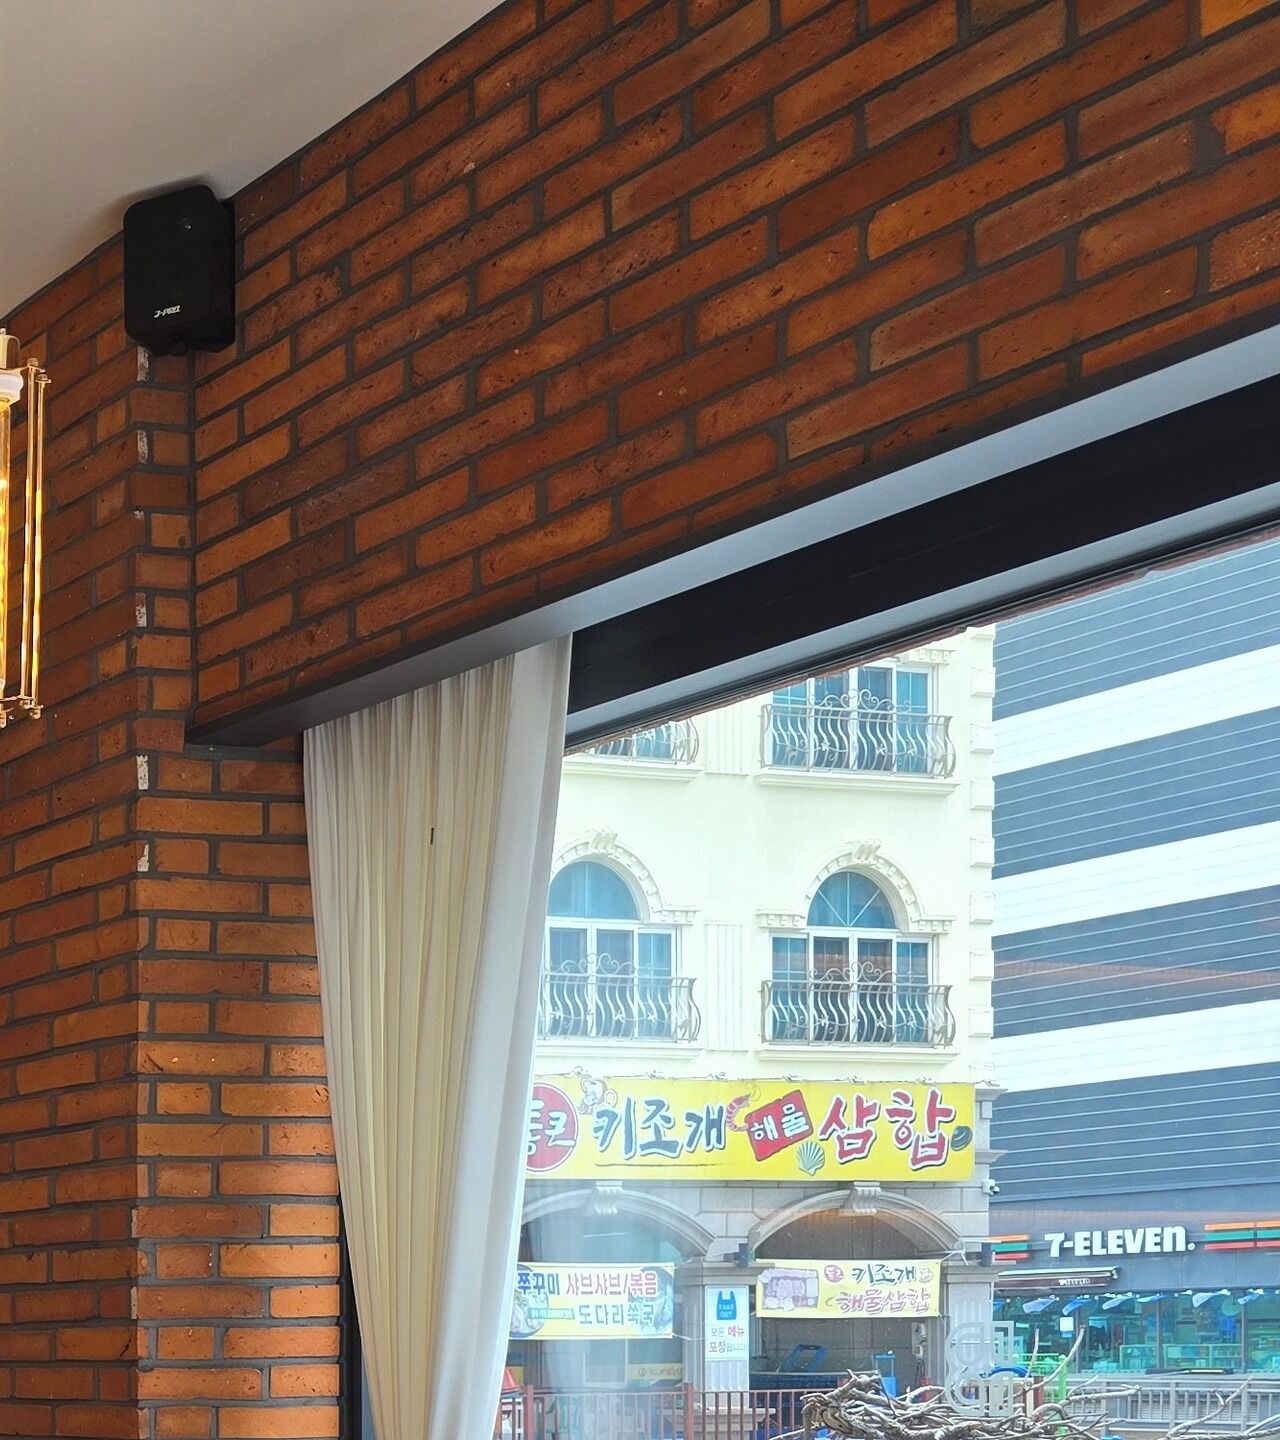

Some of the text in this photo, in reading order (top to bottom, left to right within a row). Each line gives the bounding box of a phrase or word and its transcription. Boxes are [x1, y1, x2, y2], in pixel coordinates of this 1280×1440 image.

[593, 1095, 726, 1158] 키조개
[751, 1101, 810, 1142] 해물
[819, 1087, 957, 1169] 삼합
[851, 1263, 915, 1285] 키조개
[836, 1287, 931, 1314] 해물삼합
